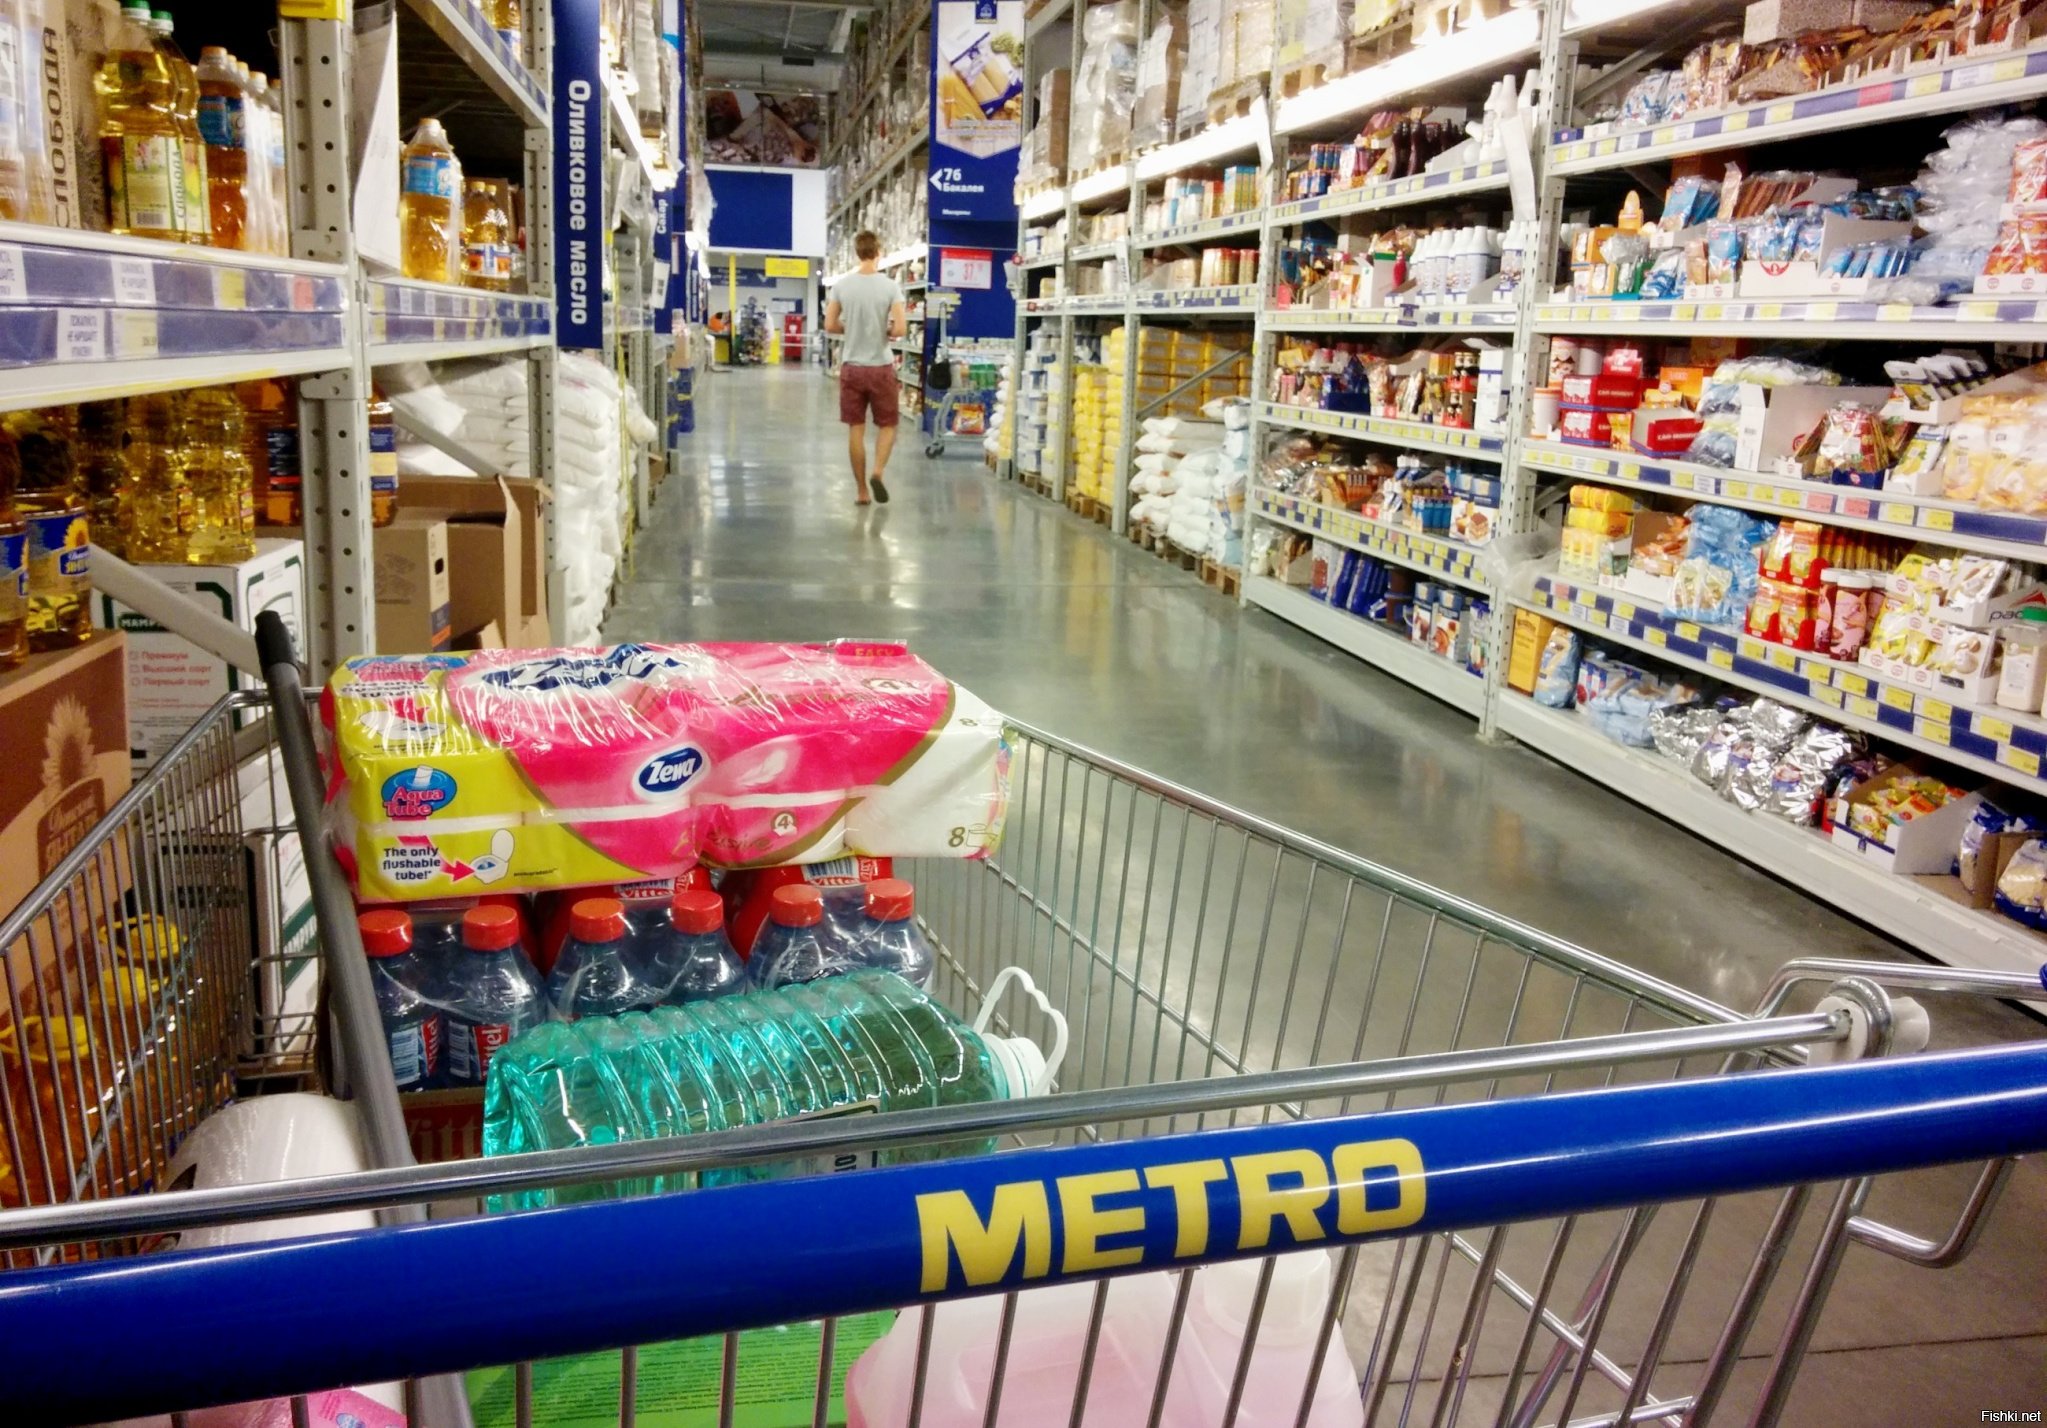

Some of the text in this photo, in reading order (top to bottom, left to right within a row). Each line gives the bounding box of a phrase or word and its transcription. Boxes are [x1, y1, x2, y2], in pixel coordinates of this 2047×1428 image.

[568, 79, 592, 325] Оливковое масло
[656, 199, 669, 234] Сахар
[649, 757, 696, 785] Zewa
[391, 786, 444, 806] Aqua
[383, 800, 432, 817] Tube
[777, 815, 790, 830] 4
[949, 826, 965, 847] 8
[384, 846, 439, 857] The only
[383, 858, 441, 870] flushable
[915, 1138, 1427, 1293] METRO
